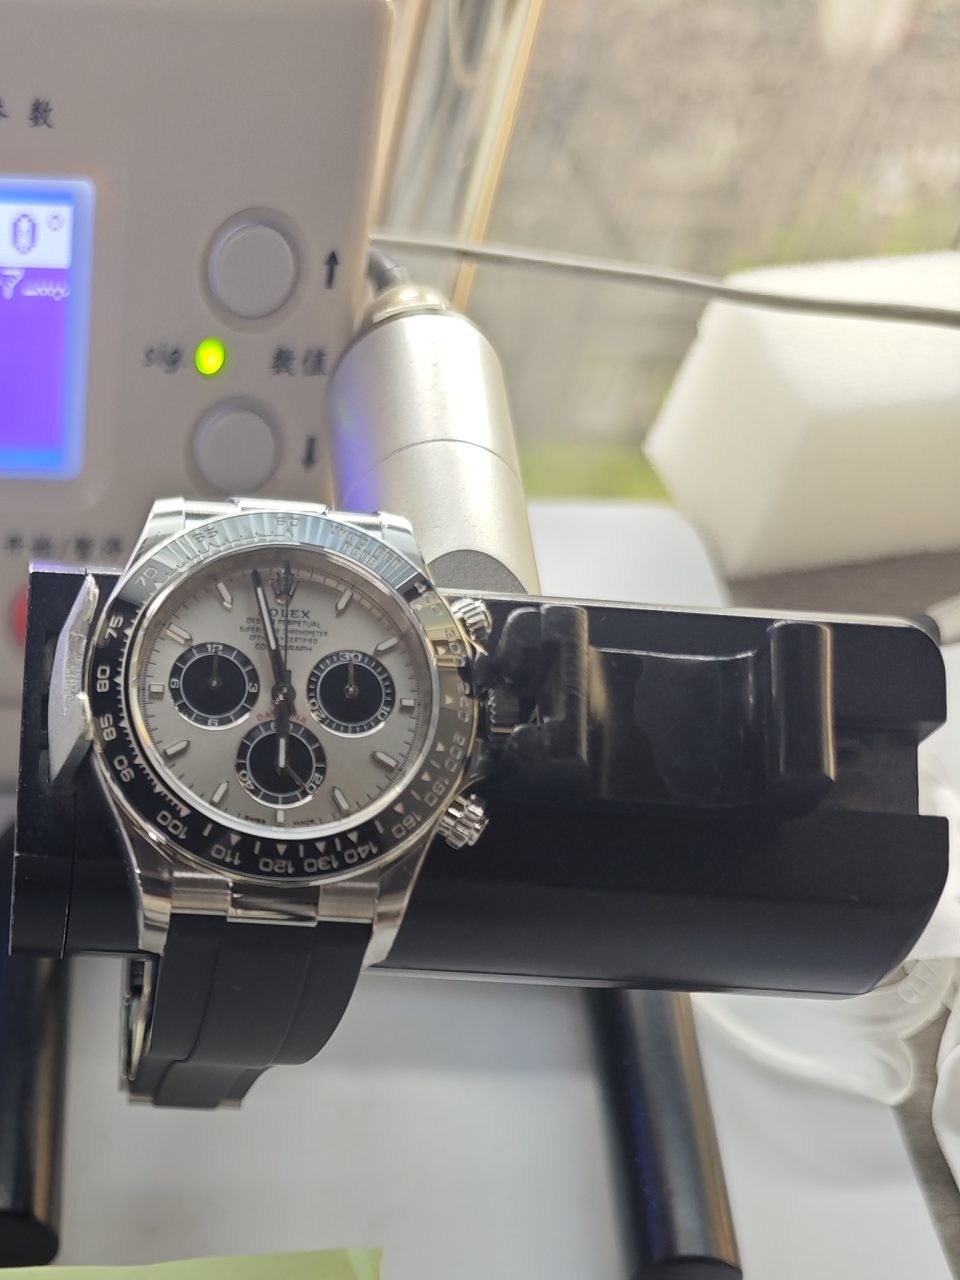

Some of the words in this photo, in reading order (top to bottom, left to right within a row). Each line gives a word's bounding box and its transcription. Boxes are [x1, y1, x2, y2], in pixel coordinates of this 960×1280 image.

[135, 567, 158, 588] 70
[258, 608, 311, 619] OLEX
[104, 614, 124, 641] 75
[340, 652, 363, 662] 30
[96, 665, 110, 693] 80
[248, 681, 259, 693] 3
[99, 713, 117, 742] 85
[444, 731, 467, 773] 200
[113, 755, 136, 783] 90
[424, 779, 450, 807] 180
[156, 810, 189, 840] 100
[391, 811, 422, 839] 160
[210, 843, 242, 866] 110
[303, 854, 339, 873] 130
[343, 840, 379, 864] 140
[259, 857, 295, 874] 120
